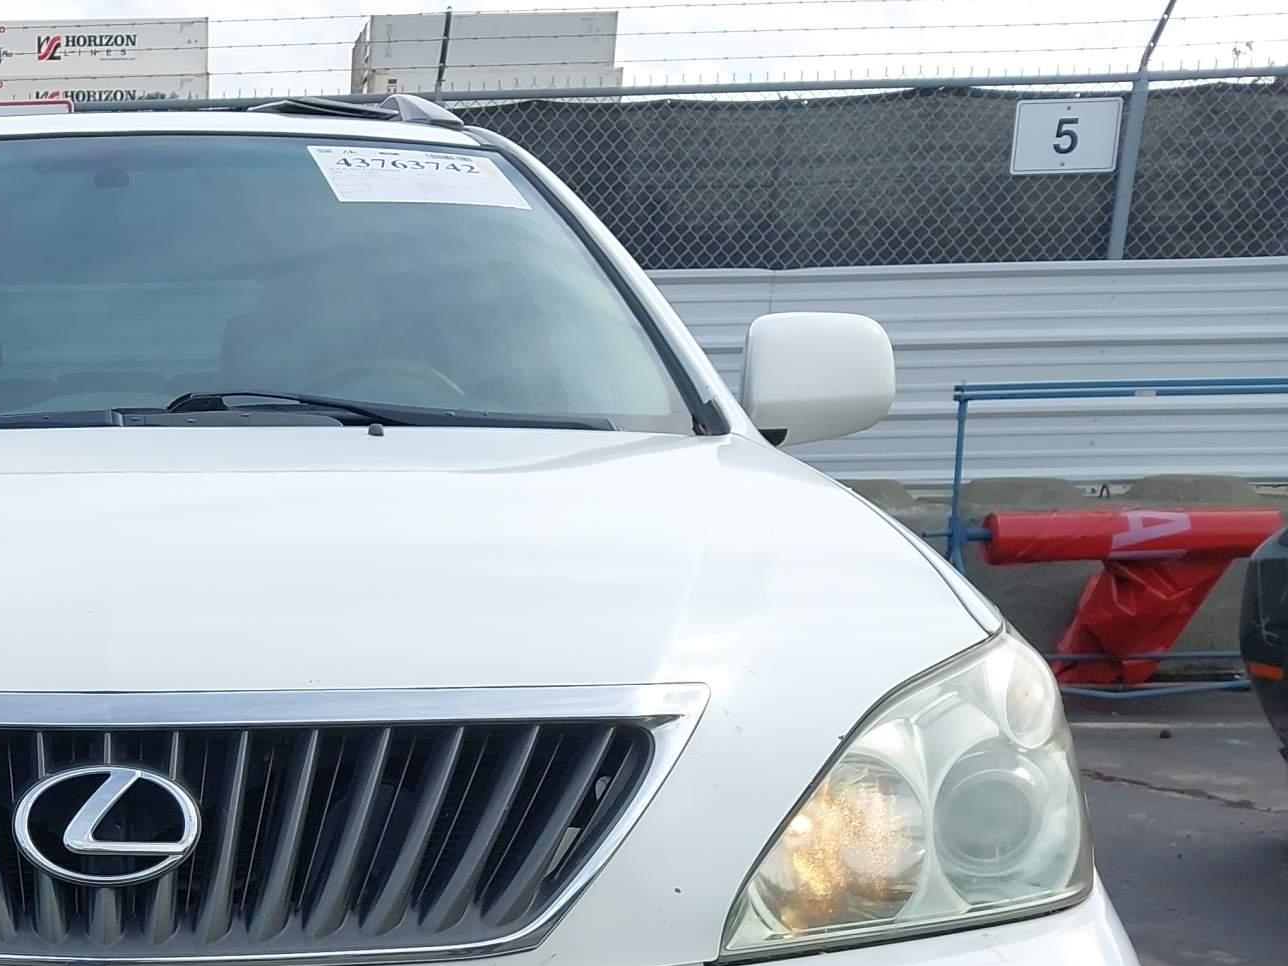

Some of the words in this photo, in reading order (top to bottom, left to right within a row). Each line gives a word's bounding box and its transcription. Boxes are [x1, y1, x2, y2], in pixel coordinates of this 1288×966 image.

[65, 34, 137, 47] HORIZON
[64, 48, 127, 56] LINES
[64, 90, 137, 101] HORIZON
[1053, 117, 1080, 154] 5
[336, 157, 480, 174] 43763742
